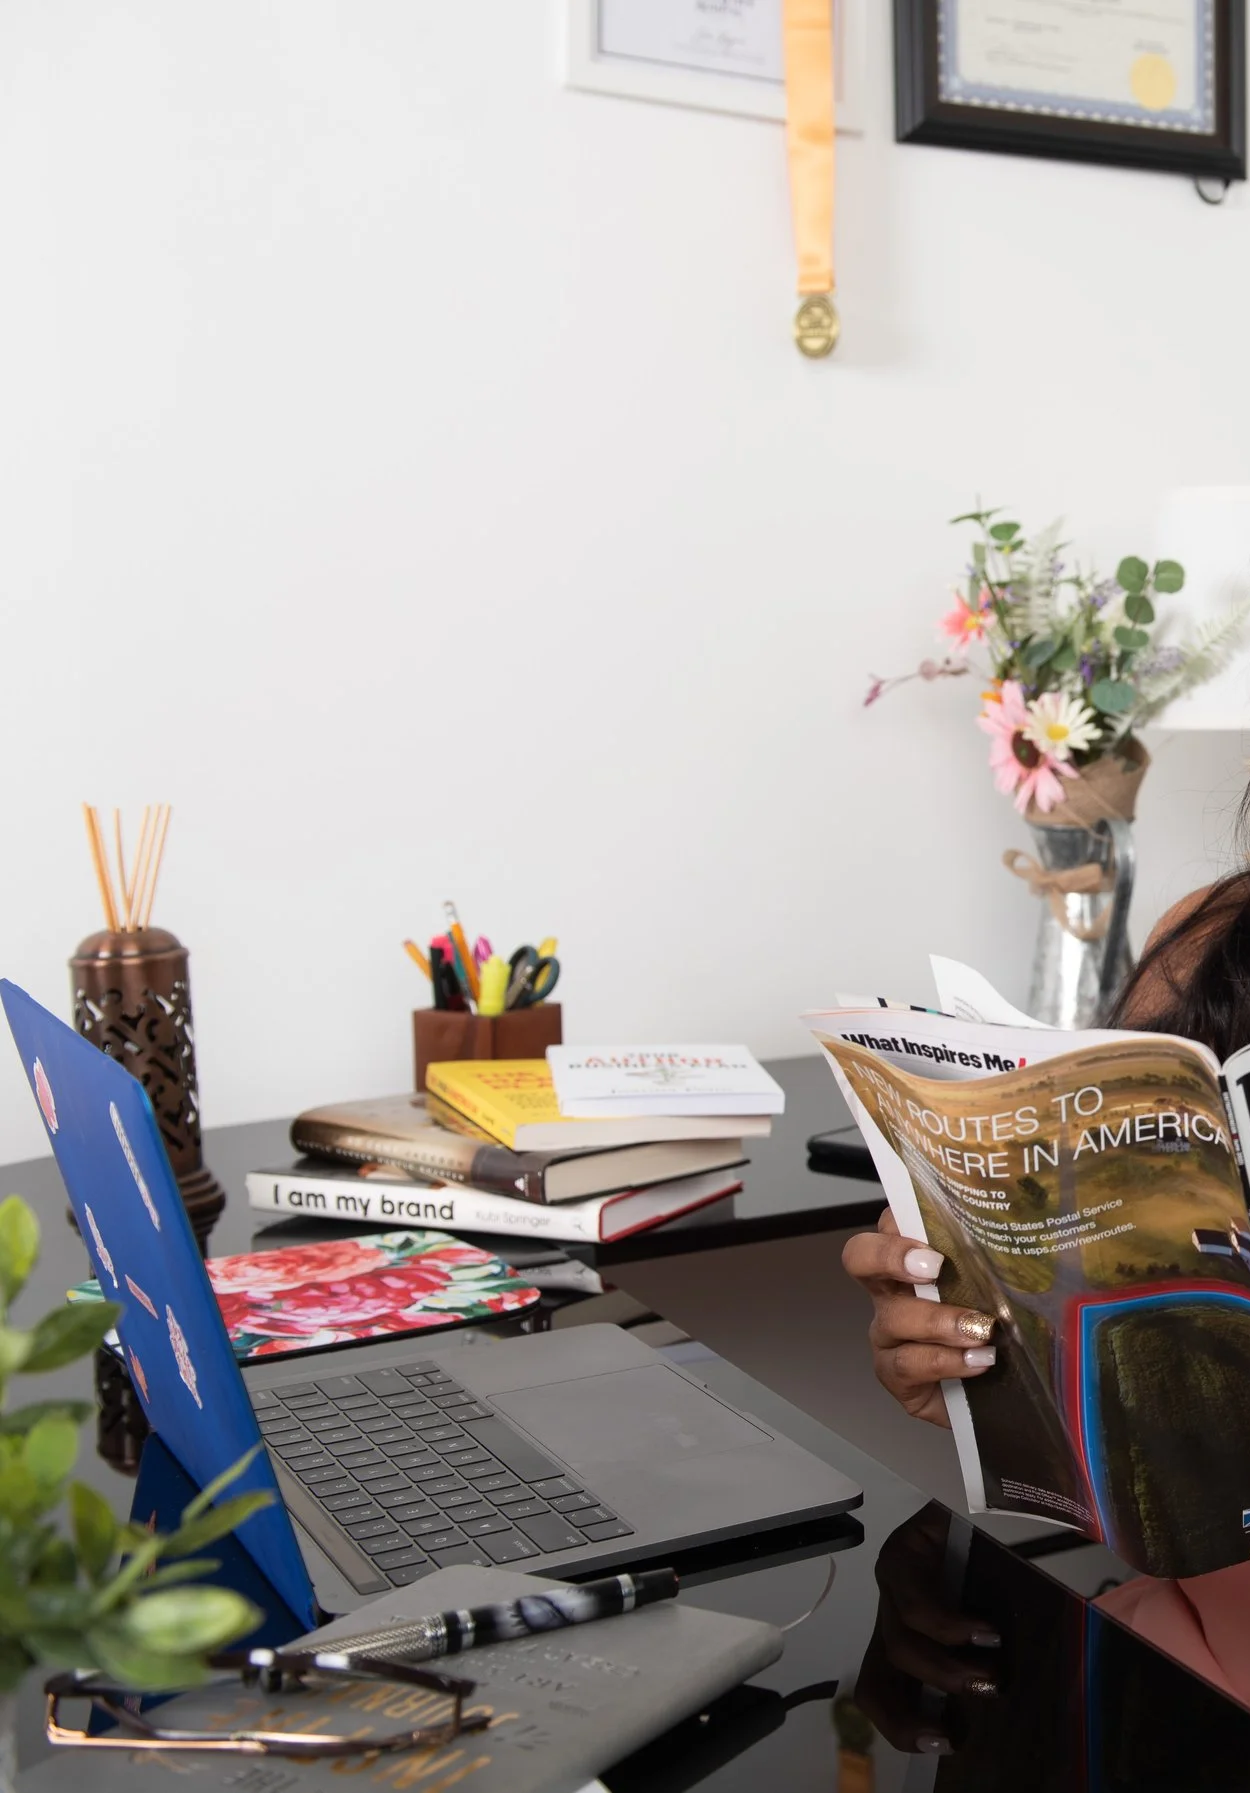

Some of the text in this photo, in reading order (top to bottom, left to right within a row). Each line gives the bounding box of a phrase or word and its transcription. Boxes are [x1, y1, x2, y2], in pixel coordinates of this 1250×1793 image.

[900, 1037, 983, 1069] Inspires
[906, 1099, 1040, 1142] ROUTES
[1051, 1086, 1104, 1123] TO
[1023, 1139, 1059, 1174] IN
[1073, 1111, 1231, 1161] AMERICA
[273, 1184, 278, 1203] I
[288, 1189, 327, 1209] am
[335, 1193, 371, 1216] my
[379, 1194, 455, 1221] brand
[962, 1195, 1011, 1212] COUNTRY
[989, 1190, 1006, 1200] TO
[979, 1217, 1008, 1231] United
[1009, 1221, 1044, 1233] States
[1046, 1210, 1081, 1228] Postal
[1083, 1198, 1123, 1218] Service
[1013, 1234, 1037, 1245] your
[1039, 1220, 1096, 1242] customers
